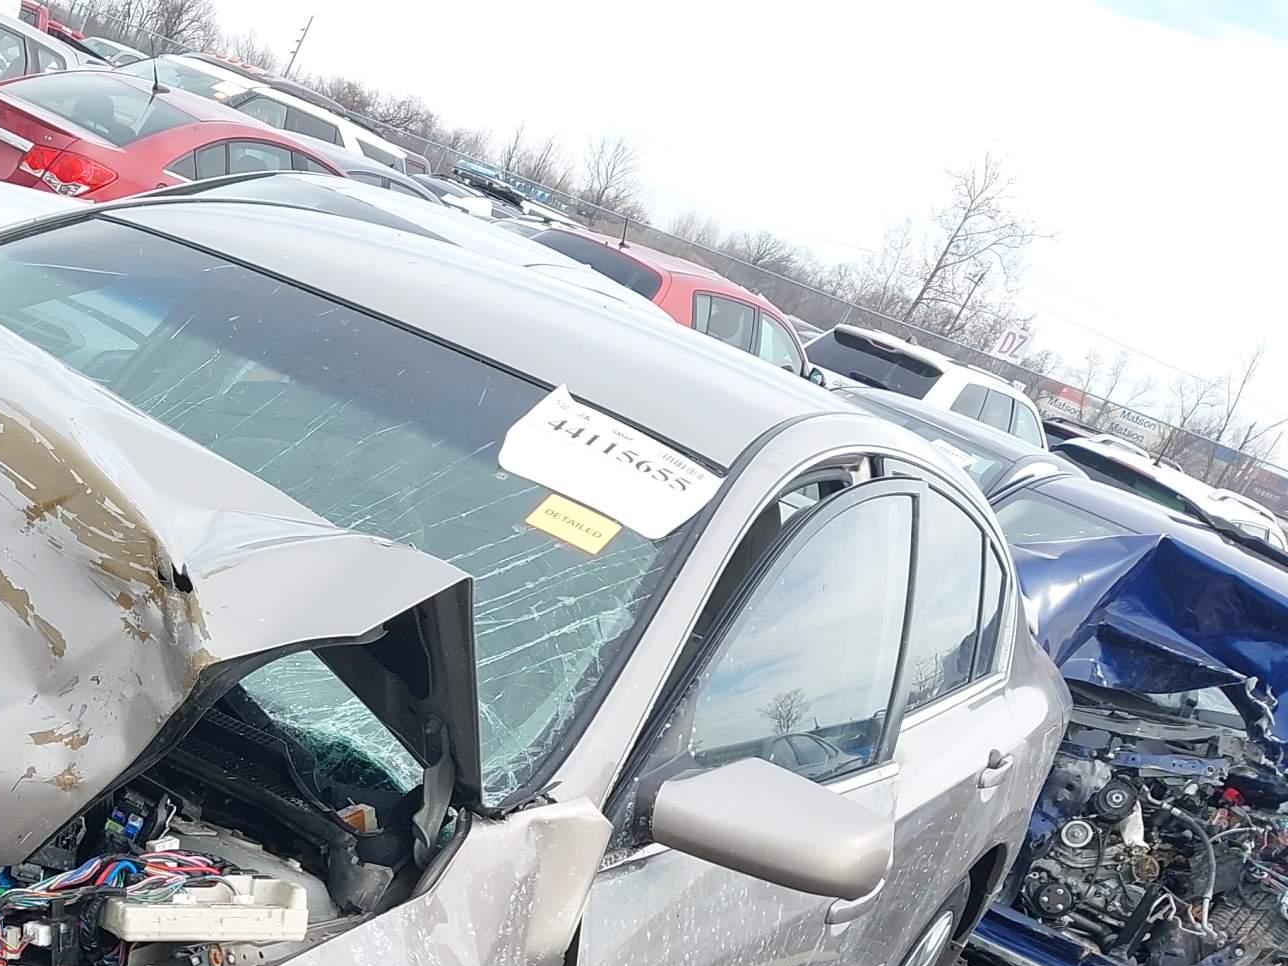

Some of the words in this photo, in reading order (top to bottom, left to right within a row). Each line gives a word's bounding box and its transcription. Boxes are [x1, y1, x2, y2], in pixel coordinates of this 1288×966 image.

[1107, 422, 1144, 442] Matson
[1119, 410, 1157, 431] Matson
[547, 419, 692, 491] 44115655
[544, 508, 602, 539] DETAILED
